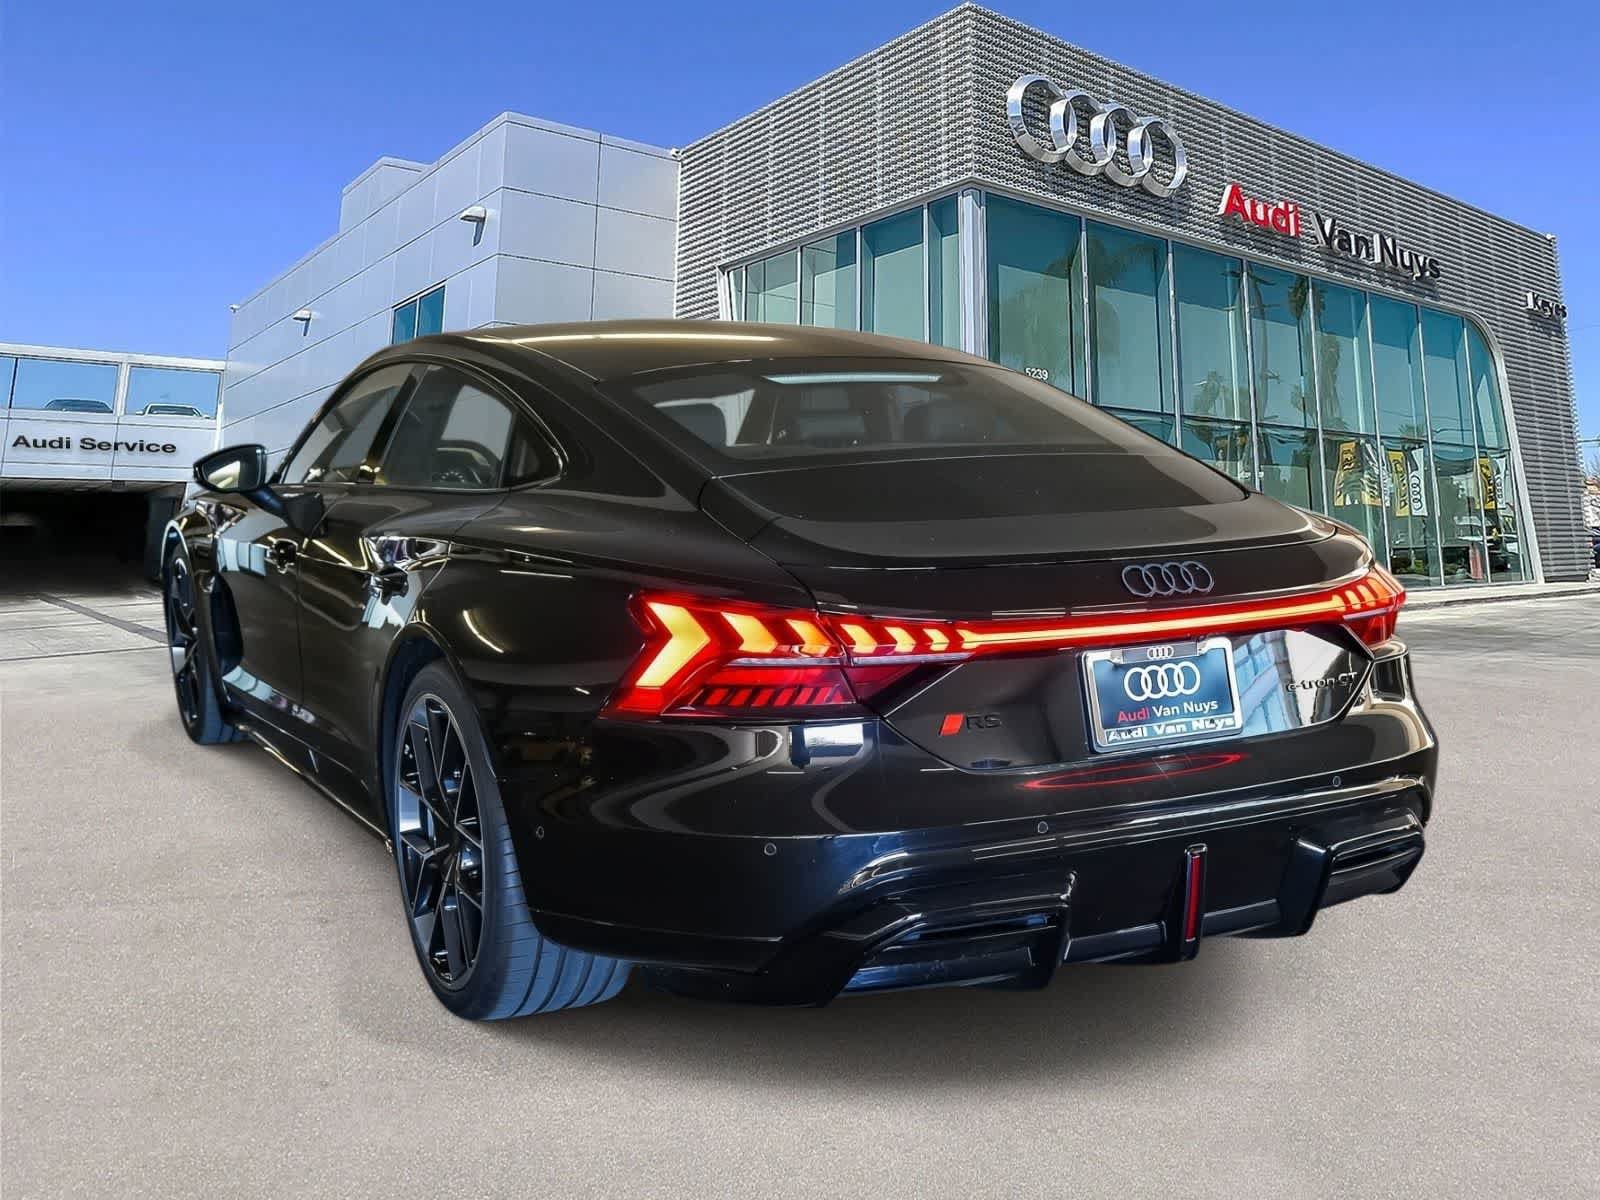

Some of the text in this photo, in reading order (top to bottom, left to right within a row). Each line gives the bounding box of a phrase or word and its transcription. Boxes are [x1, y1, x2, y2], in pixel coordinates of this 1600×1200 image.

[1218, 181, 1441, 280] Audi Van Nuys
[1025, 367, 1049, 380] 5239
[12, 435, 177, 453] Audi Service
[1338, 671, 1358, 686] GT
[1117, 699, 1219, 723] Audi Van Nuys
[1108, 715, 1236, 742] Audi Van Nuys
